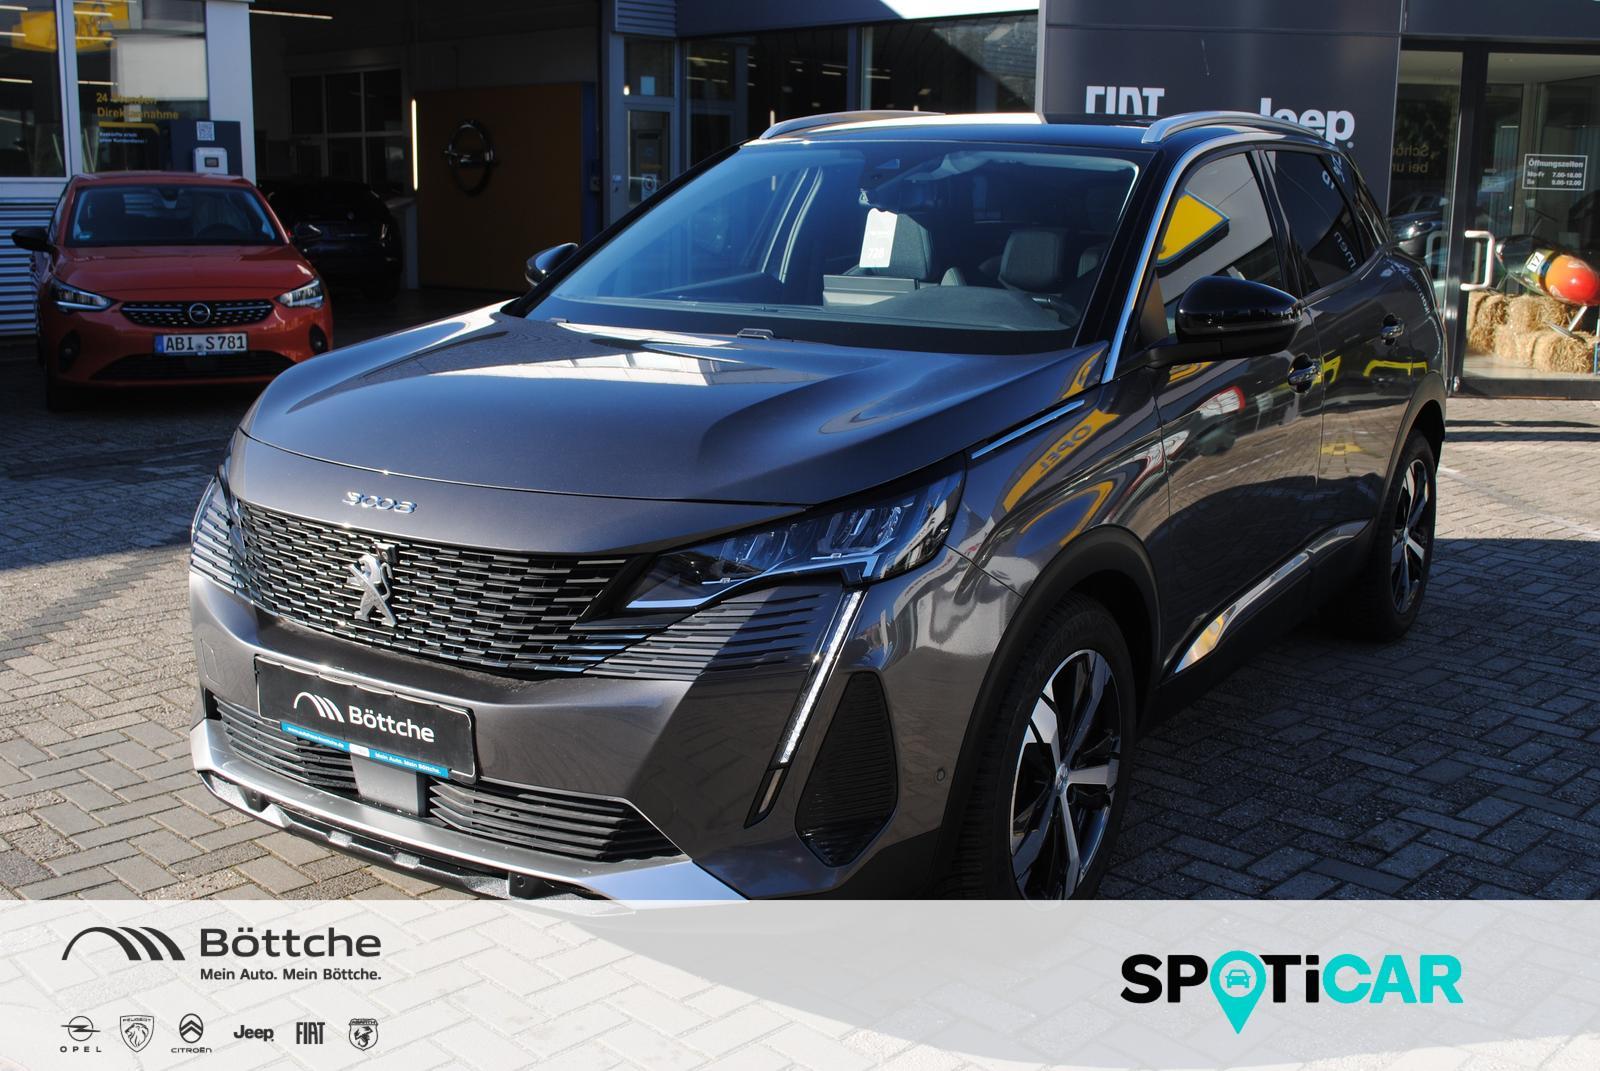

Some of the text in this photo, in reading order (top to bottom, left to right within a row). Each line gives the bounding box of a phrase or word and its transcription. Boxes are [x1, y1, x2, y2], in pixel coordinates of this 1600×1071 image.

[1528, 158, 1584, 168] Öffnungszeiten
[166, 337, 194, 351] ABI
[348, 705, 435, 743] Böttche
